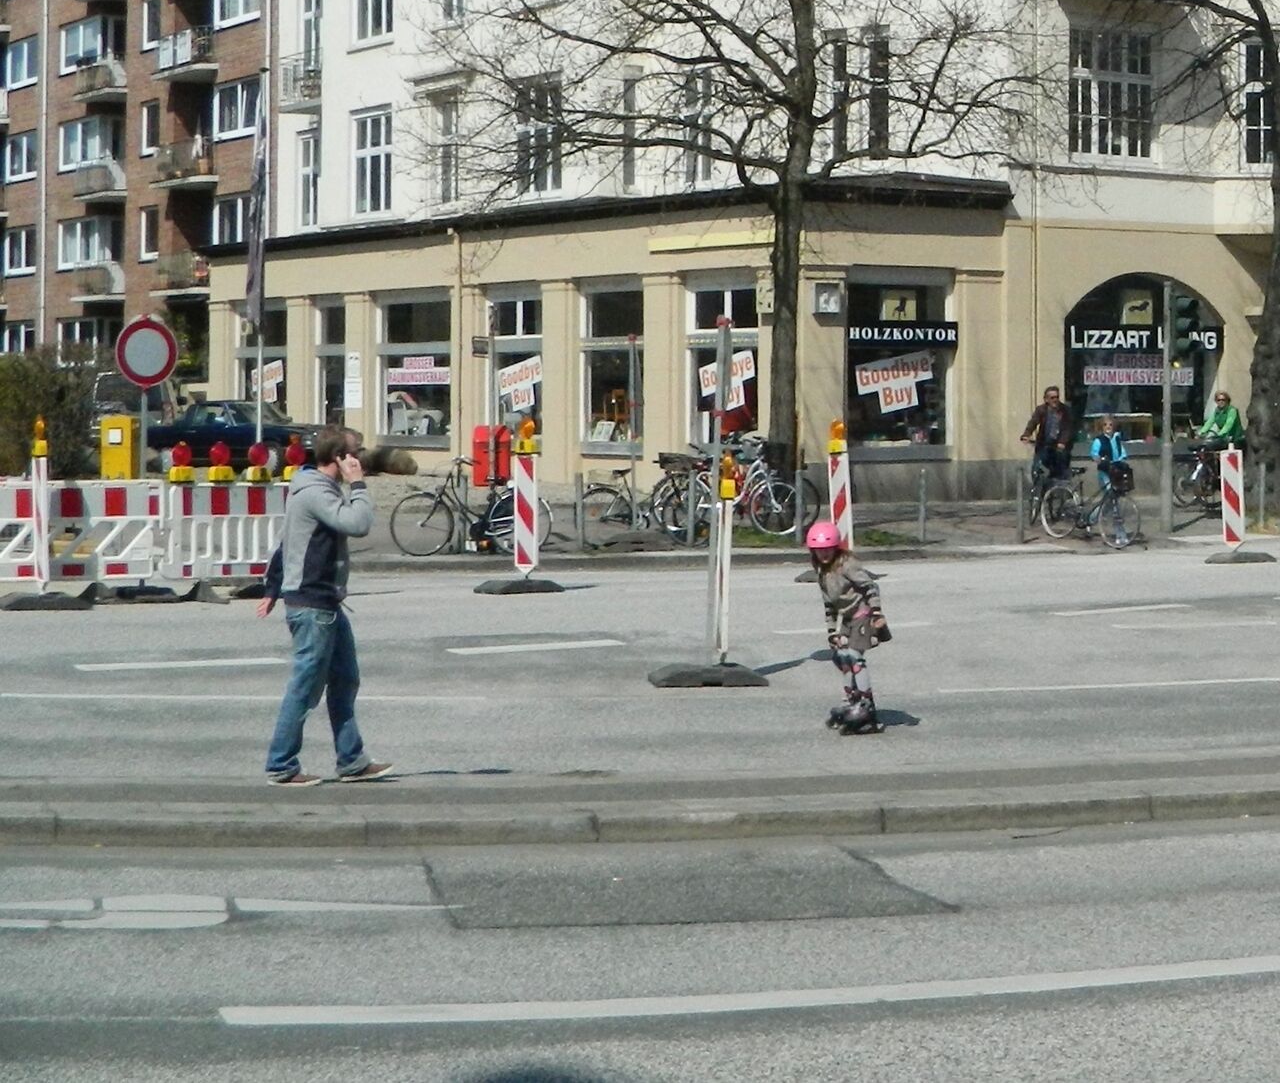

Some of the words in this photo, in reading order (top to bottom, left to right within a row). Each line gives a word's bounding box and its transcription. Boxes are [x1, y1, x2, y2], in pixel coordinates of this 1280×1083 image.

[849, 327, 957, 341] HOLZKONTOR
[1070, 325, 1150, 349] LIZZART
[501, 363, 541, 388] Goodbye
[859, 357, 929, 387] Goodbye
[513, 388, 532, 406] Buy
[882, 386, 913, 407] Buy
